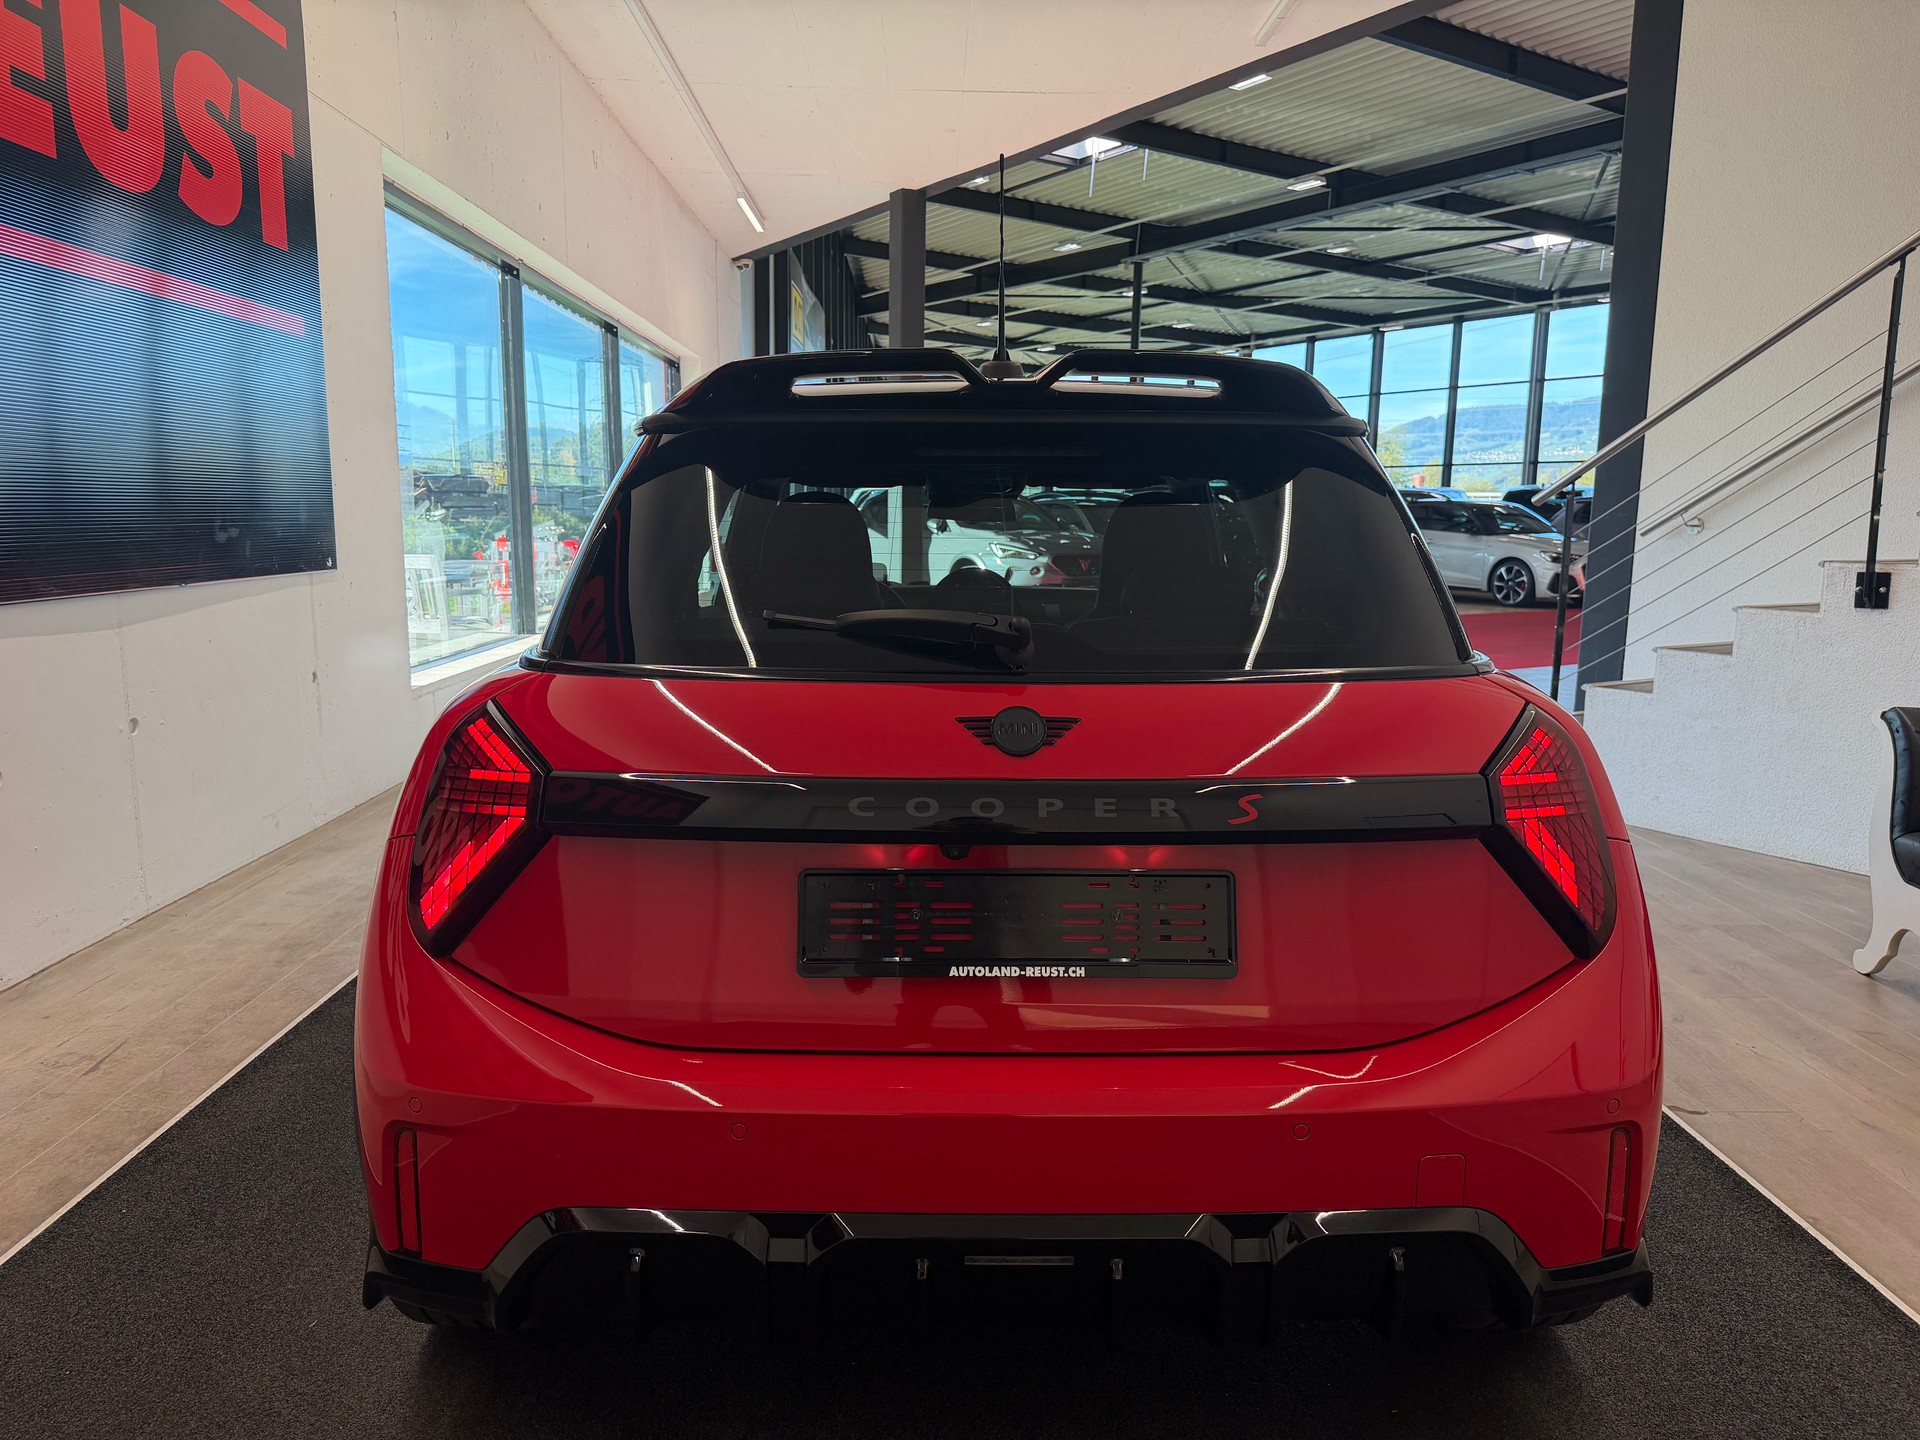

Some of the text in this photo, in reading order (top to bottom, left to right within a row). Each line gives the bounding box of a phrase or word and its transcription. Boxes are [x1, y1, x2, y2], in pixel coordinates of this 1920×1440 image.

[999, 722, 1039, 736] MINI
[849, 794, 1263, 825] COOPER S
[949, 966, 1086, 977] AUTOLAND-REUST.CH
